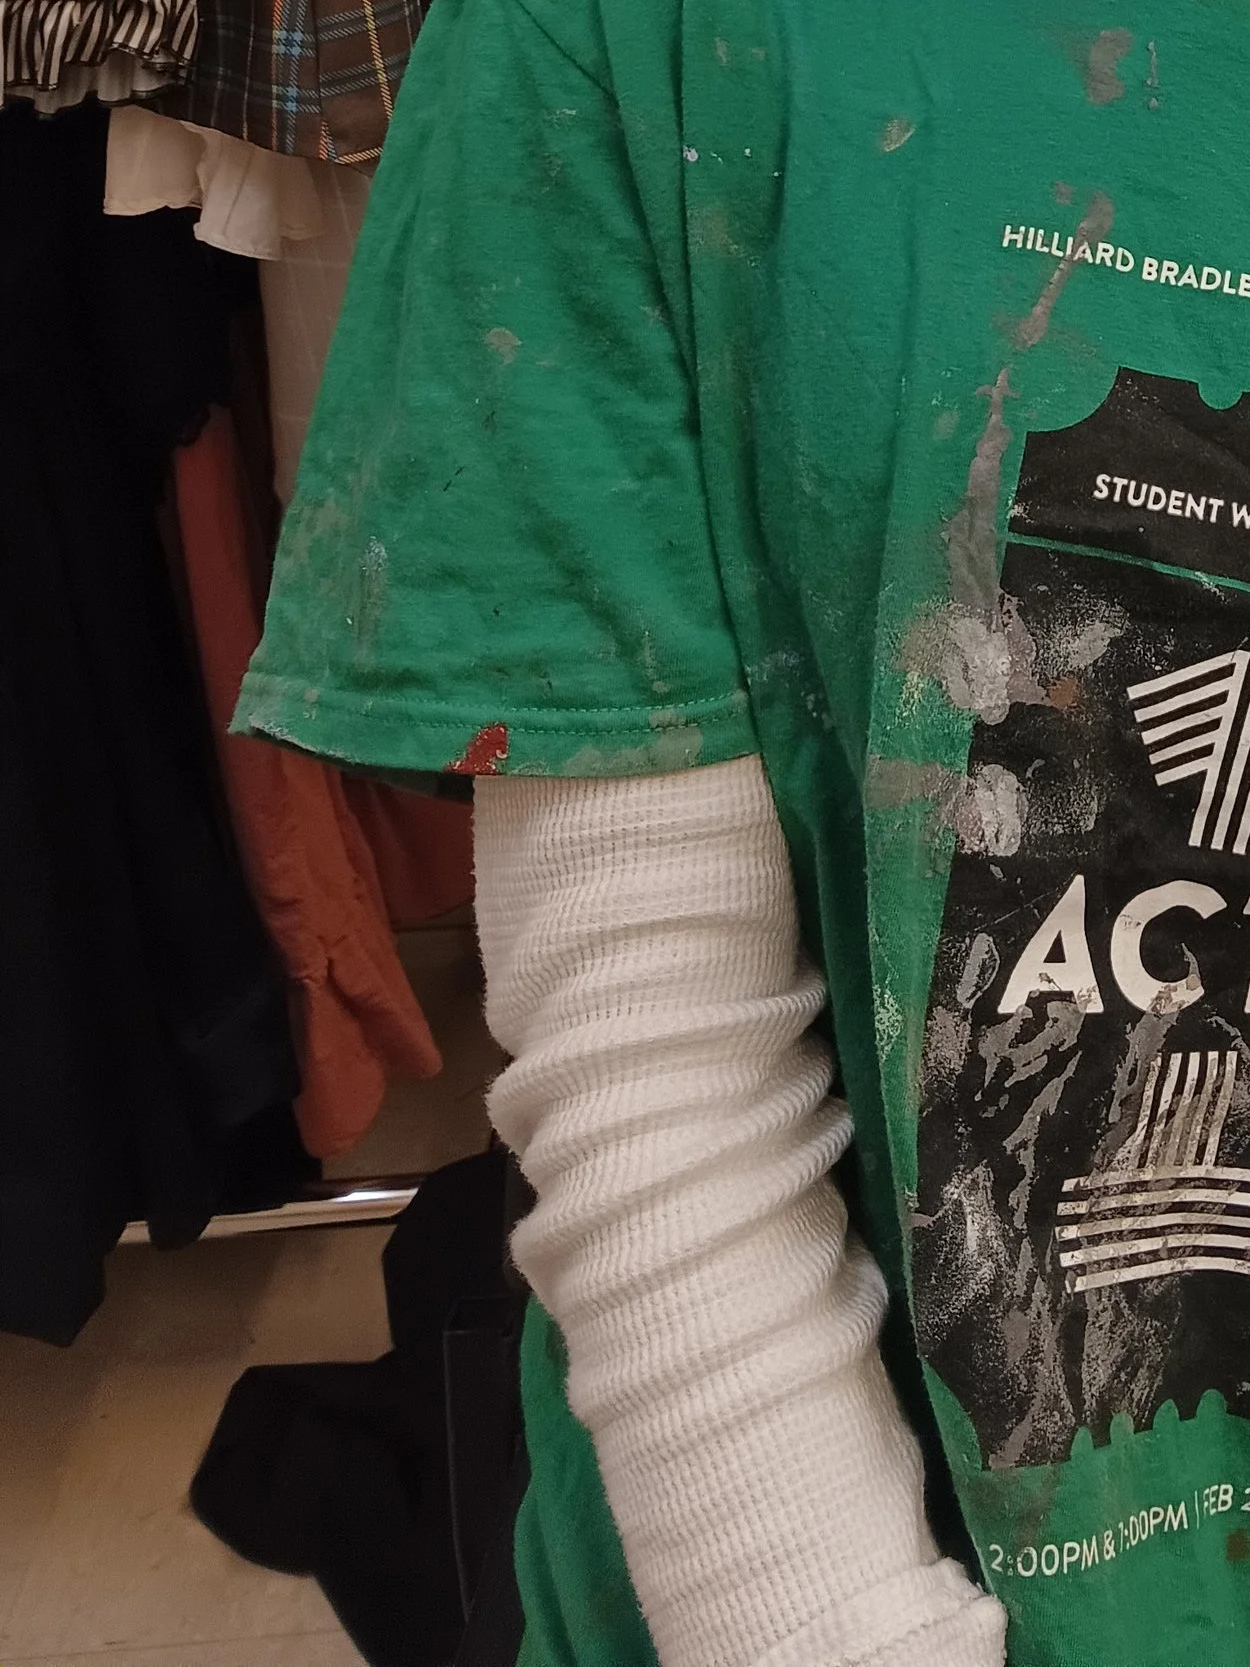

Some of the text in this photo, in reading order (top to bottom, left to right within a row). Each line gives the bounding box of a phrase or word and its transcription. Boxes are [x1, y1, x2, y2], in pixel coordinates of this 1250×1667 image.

[1002, 224, 1135, 274] HILLIARD
[1093, 473, 1226, 524] STUDENT
[989, 1535, 1100, 1577] 2:00PM
[1103, 1529, 1116, 1561] &
[1203, 1483, 1235, 1518] FEB
